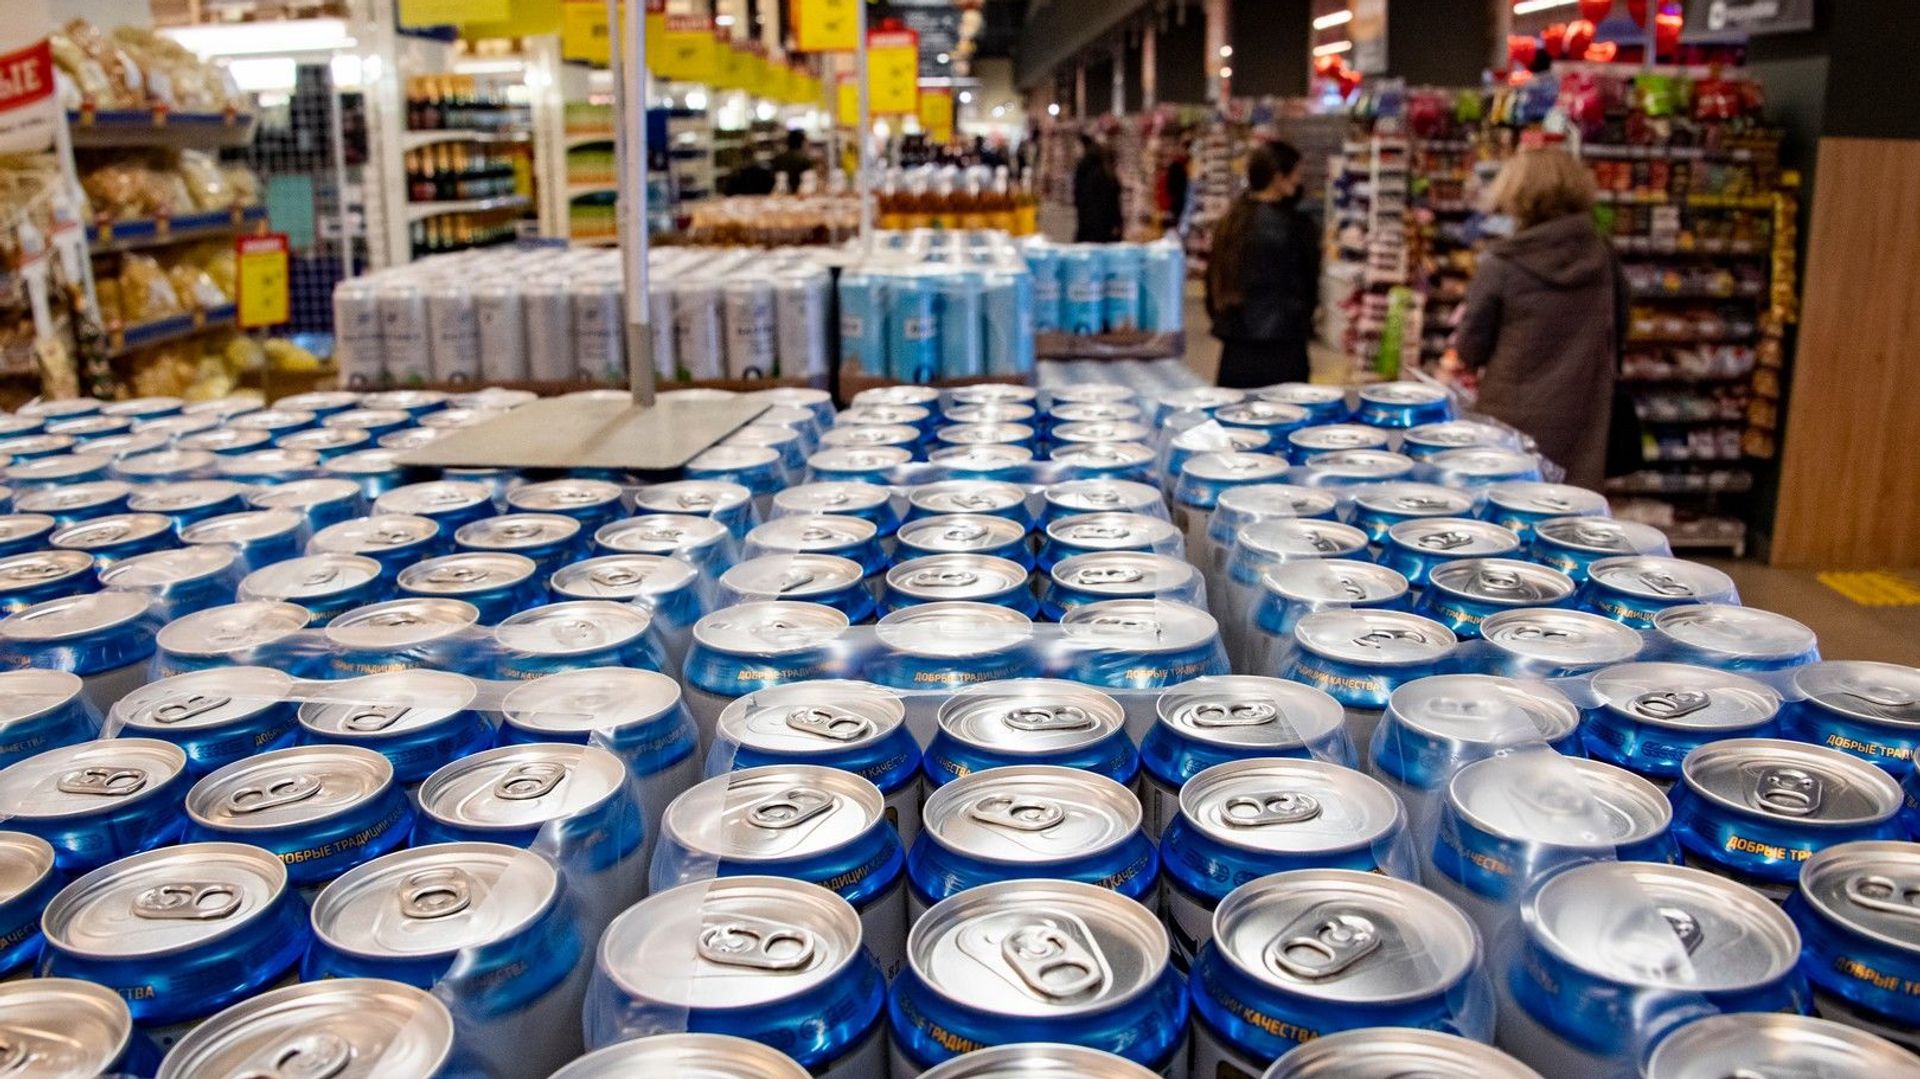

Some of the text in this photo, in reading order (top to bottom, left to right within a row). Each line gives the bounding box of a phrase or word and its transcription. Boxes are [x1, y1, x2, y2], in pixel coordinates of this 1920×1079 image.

[1826, 734, 1913, 760] ДОБРЫЕ ТРАД
[1725, 836, 1786, 860] ДОБРЫЕ
[1243, 1006, 1320, 1044] КАЧЕСТВА
